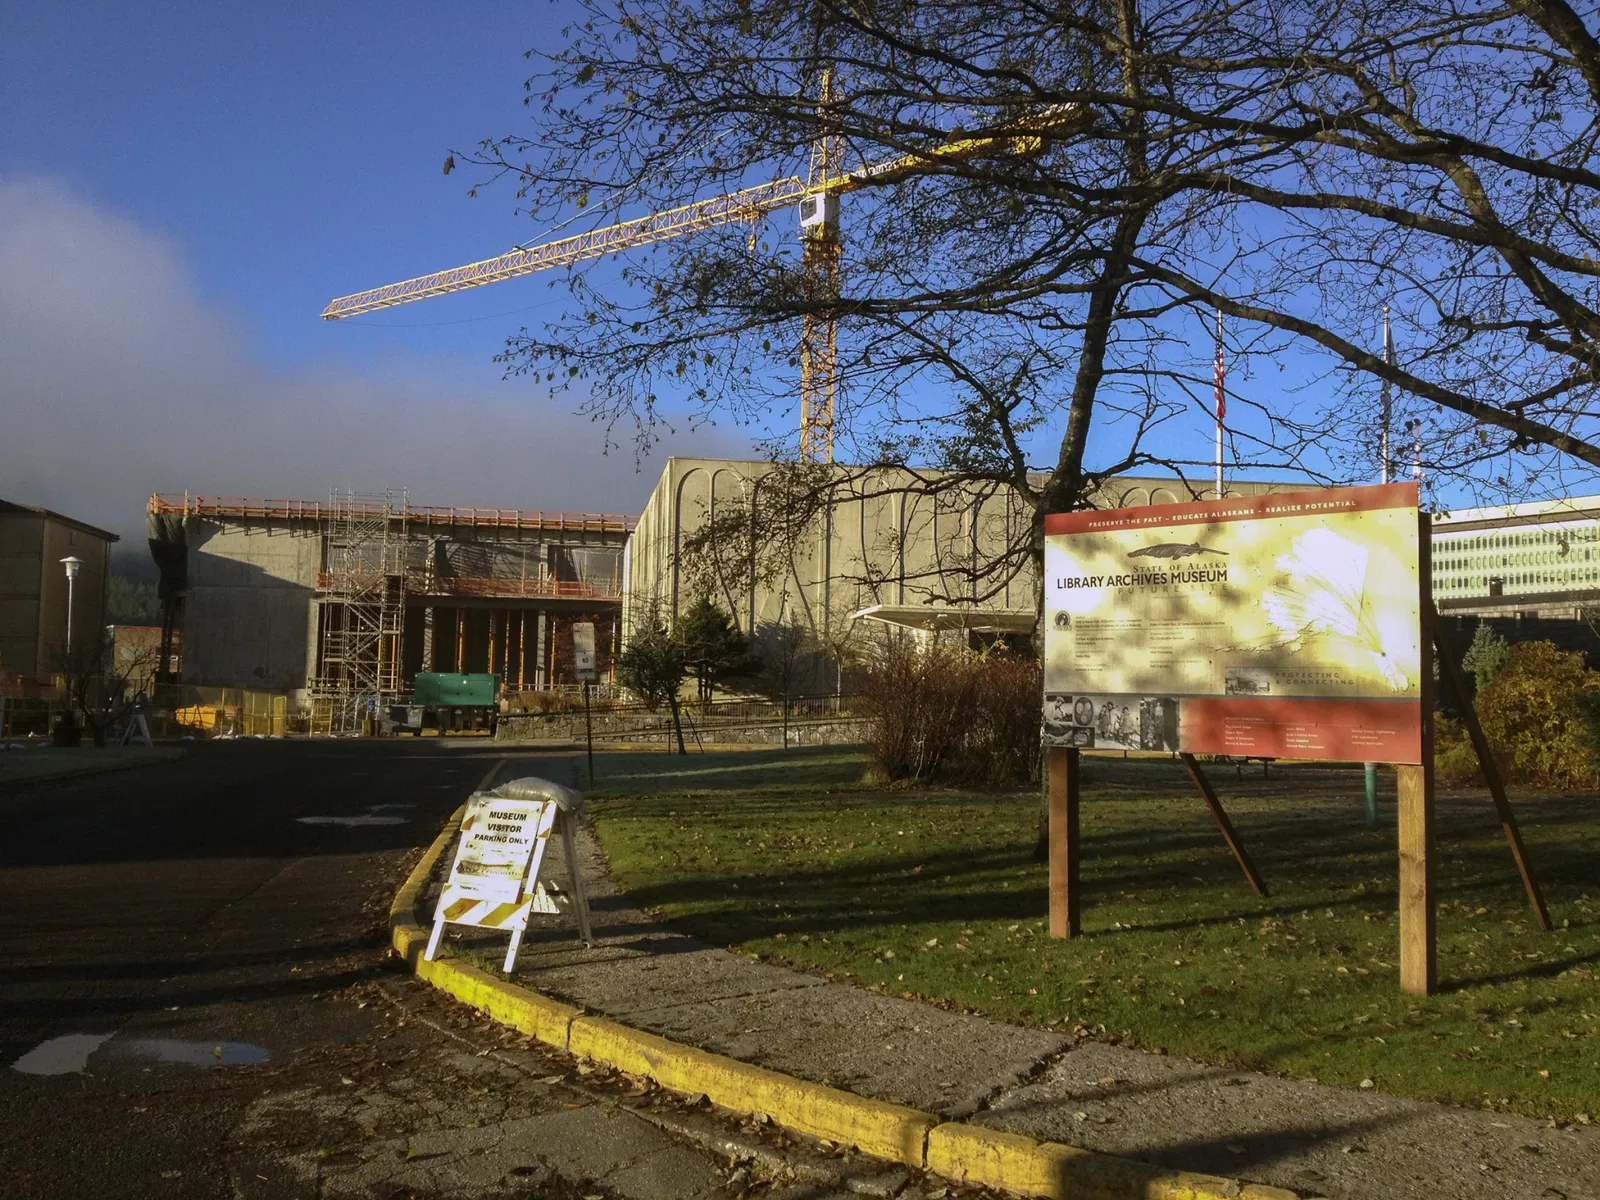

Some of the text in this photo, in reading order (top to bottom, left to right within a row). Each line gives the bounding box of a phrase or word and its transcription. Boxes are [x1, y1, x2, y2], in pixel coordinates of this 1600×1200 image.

[1088, 519, 1123, 528] PRESERVE
[1172, 512, 1208, 521] EDUCATE
[1211, 508, 1254, 518] ALASKANS
[1265, 504, 1302, 513] REALIZE
[1305, 500, 1356, 510] POTENTIAL
[1057, 569, 1228, 589] LIBRARY ARCHIVES MUSEUM
[1117, 583, 1228, 595] FUTURE SITE
[489, 811, 527, 821] MUSEUM
[487, 823, 522, 832] VISITOR
[474, 833, 508, 843] PARKING
